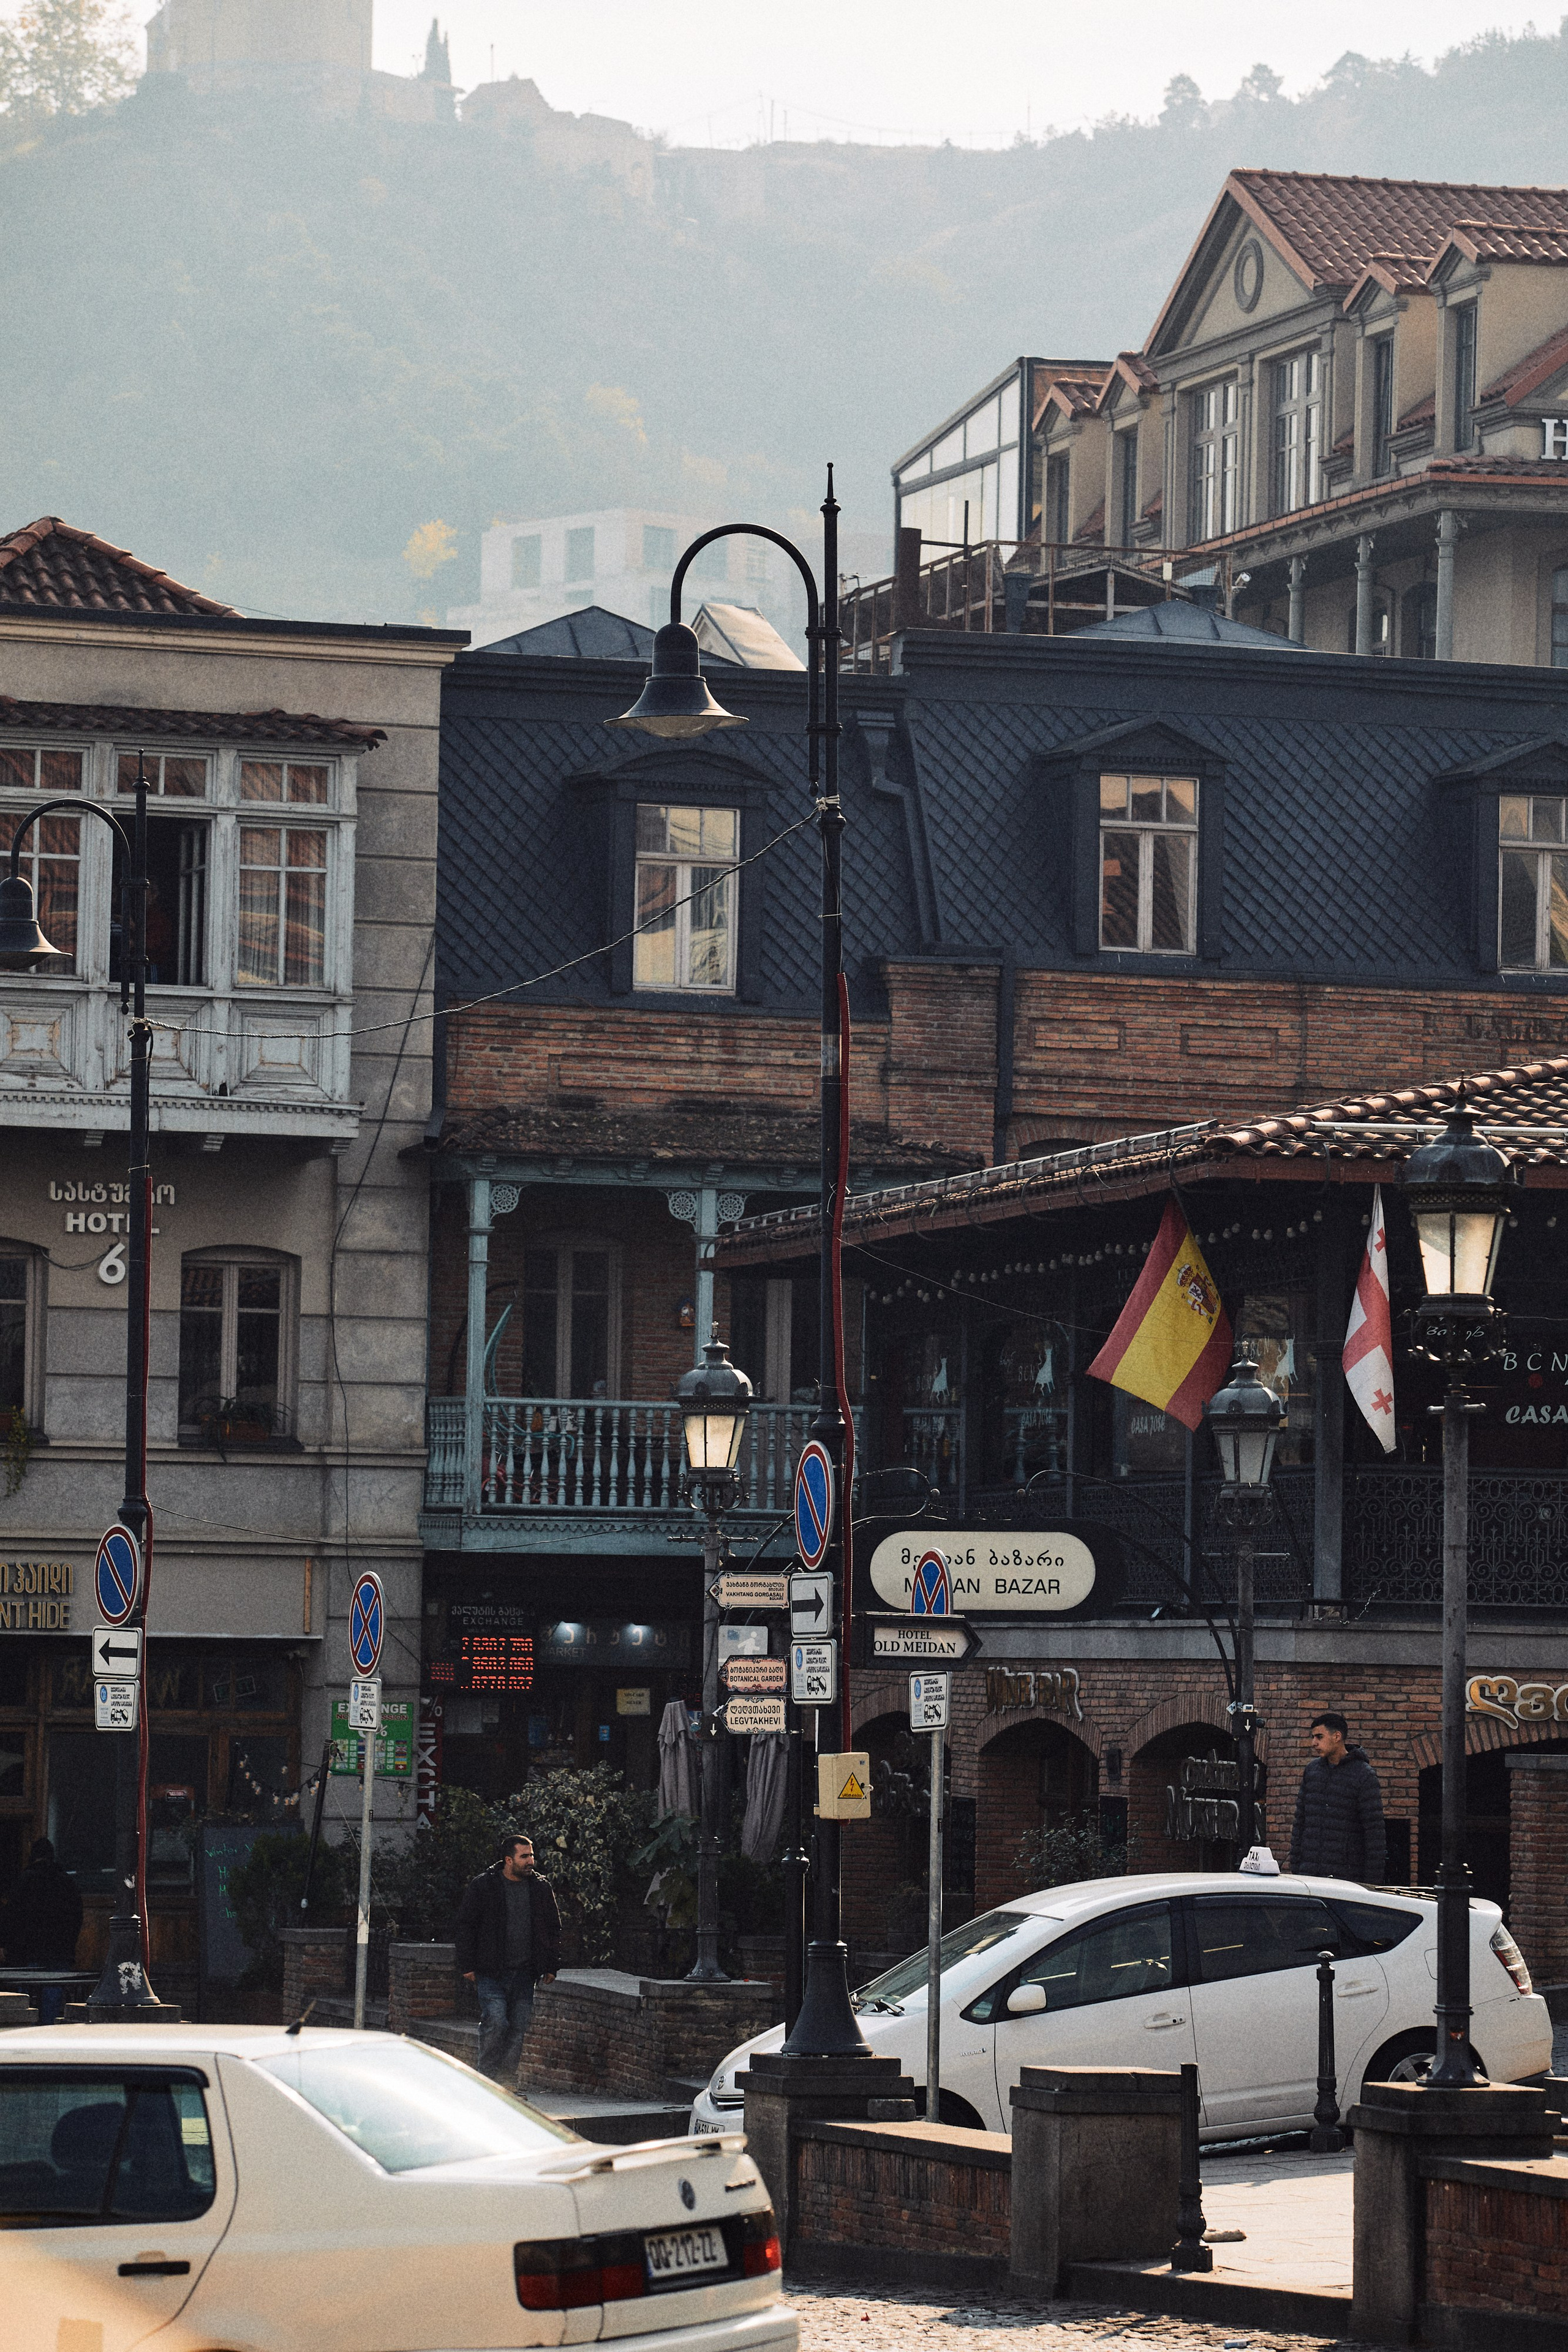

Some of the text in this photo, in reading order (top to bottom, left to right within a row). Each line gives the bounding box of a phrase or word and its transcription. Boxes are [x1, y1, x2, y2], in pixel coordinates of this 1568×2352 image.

[50, 1181, 175, 1204] სასტუო
[66, 1212, 160, 1234] HOT
[99, 1242, 126, 1284] 6
[989, 1549, 1064, 1567] ბაზარი
[13, 1563, 73, 1593] ჰაიდი
[905, 1578, 1060, 1594] MAN BAZAR
[29, 1602, 72, 1629] HIDE
[462, 1617, 524, 1626] EXCHANGE
[898, 1630, 932, 1640] HOTEL
[874, 1640, 956, 1654] OLD MEIDAN
[730, 1705, 780, 1714] ლეღვთახევი
